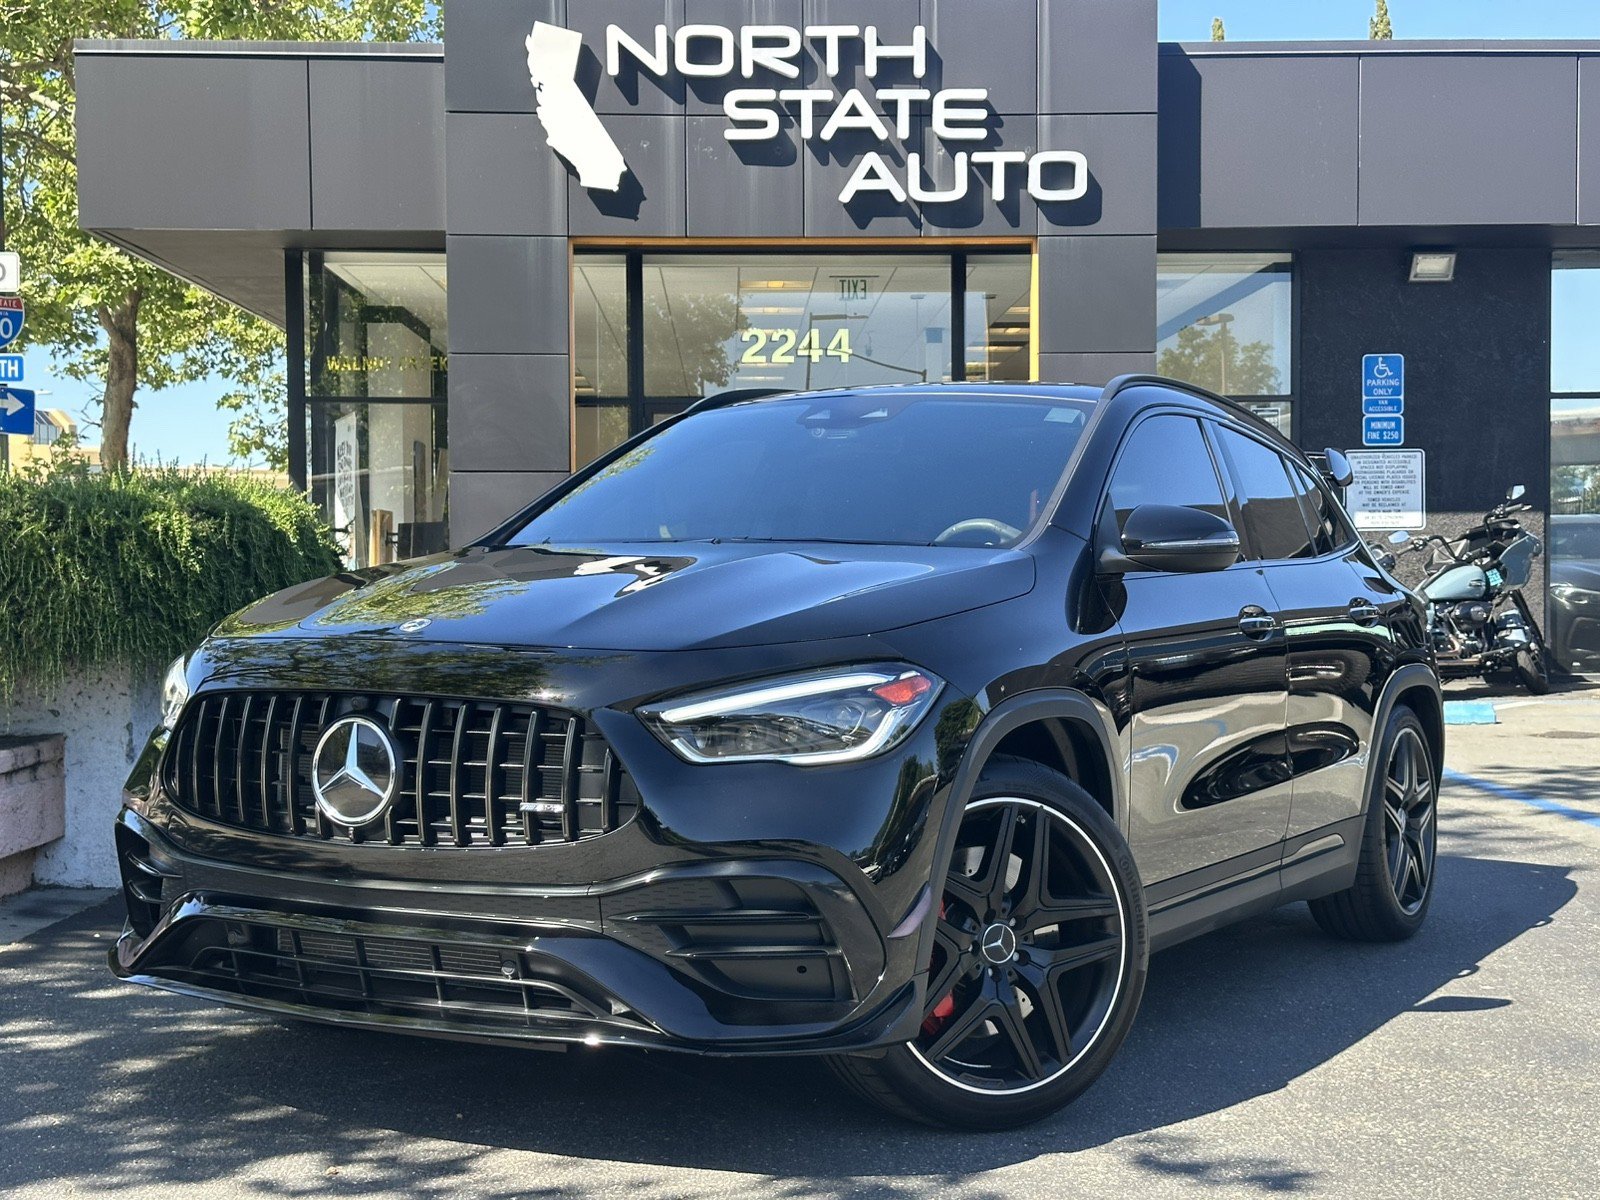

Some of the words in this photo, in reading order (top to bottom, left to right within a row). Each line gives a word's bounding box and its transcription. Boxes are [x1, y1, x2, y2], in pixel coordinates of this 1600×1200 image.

[605, 23, 928, 79] NORTH
[722, 87, 990, 142] STATE
[837, 149, 1089, 204] AUTO
[741, 328, 853, 363] 2244
[1366, 379, 1400, 387] PARKING
[1367, 431, 1380, 440] FINE
[1383, 431, 1399, 440] $250
[1370, 421, 1395, 430] MINIMUM
